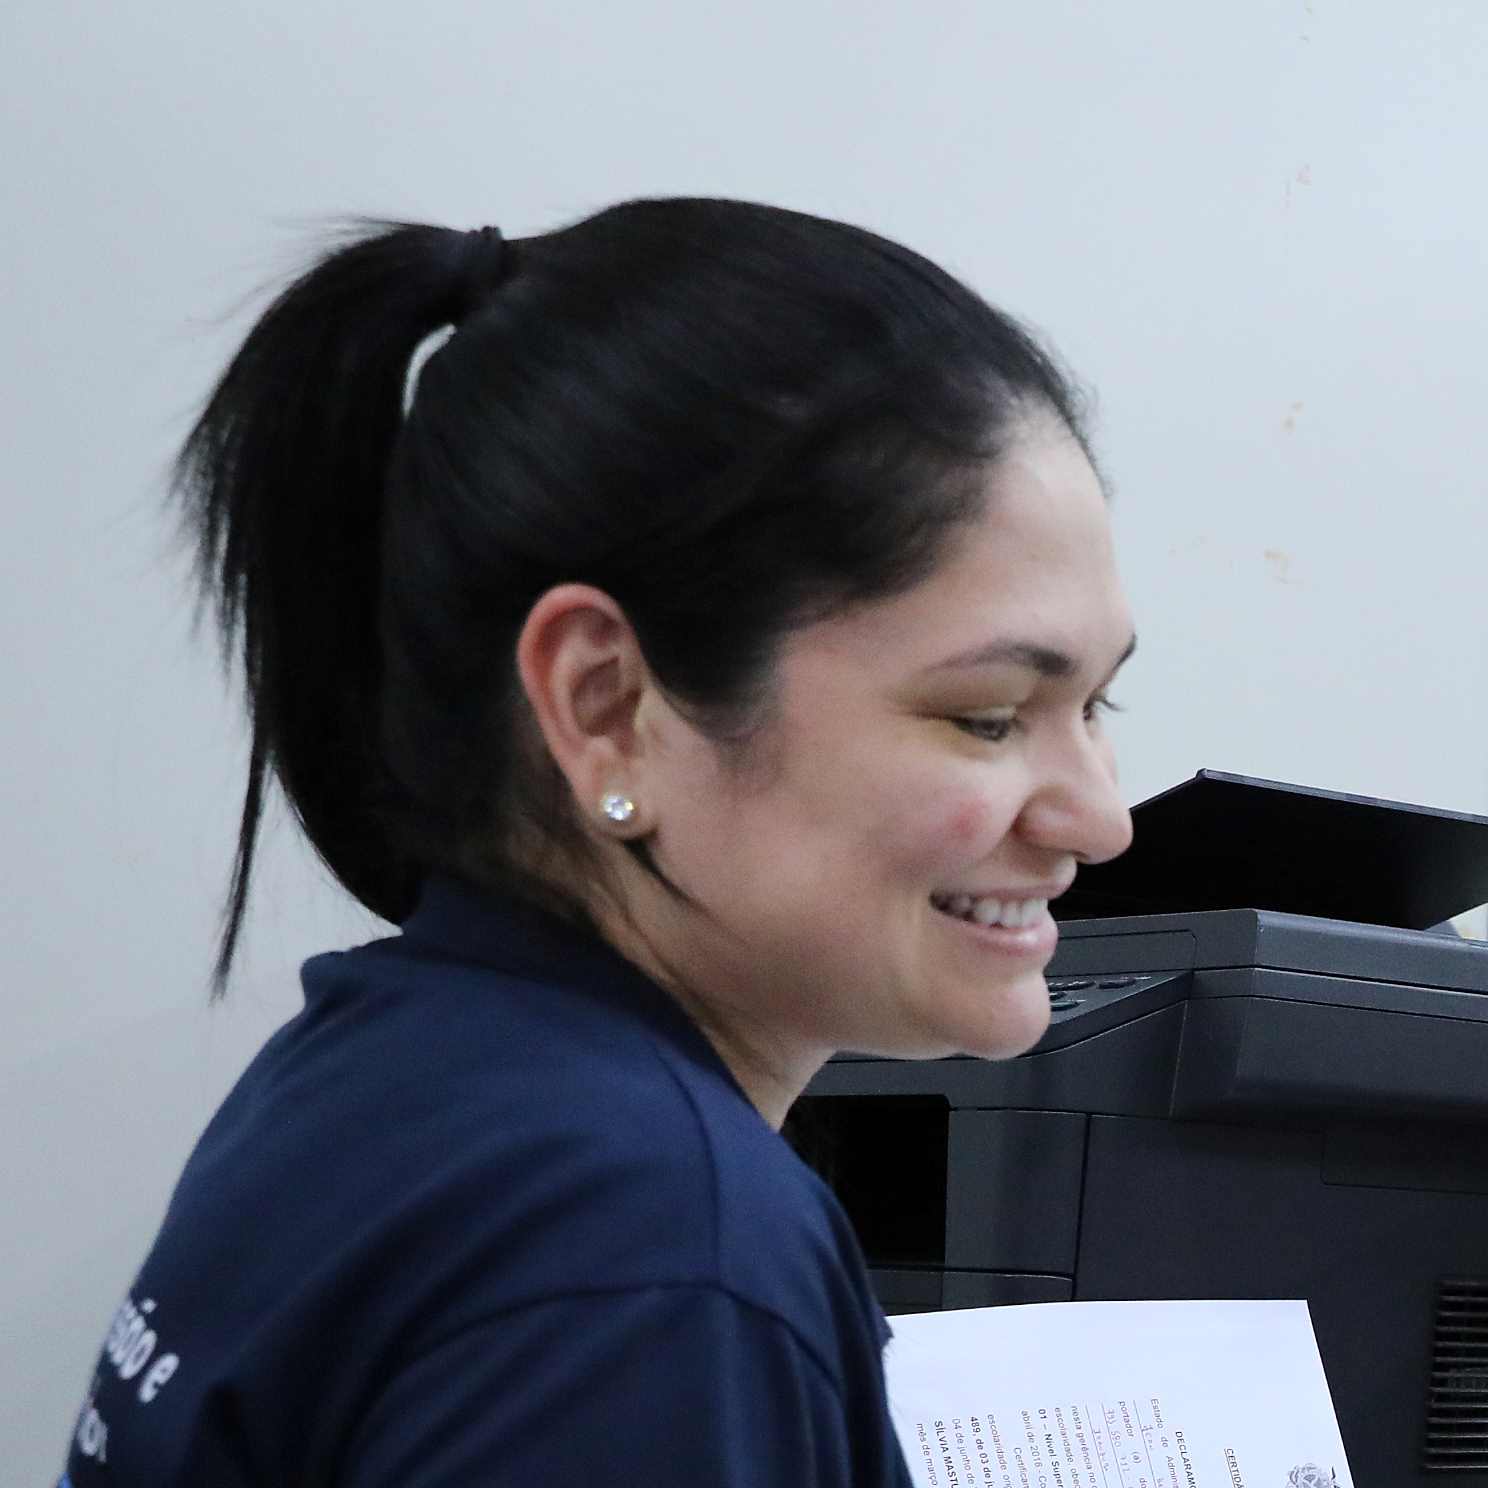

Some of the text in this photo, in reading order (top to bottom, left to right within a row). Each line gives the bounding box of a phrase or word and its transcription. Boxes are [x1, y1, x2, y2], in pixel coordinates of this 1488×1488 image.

[932, 1420, 952, 1453] SÍLVIA
[967, 1416, 982, 1437] 489,
[1042, 1433, 1057, 1457] Nível
